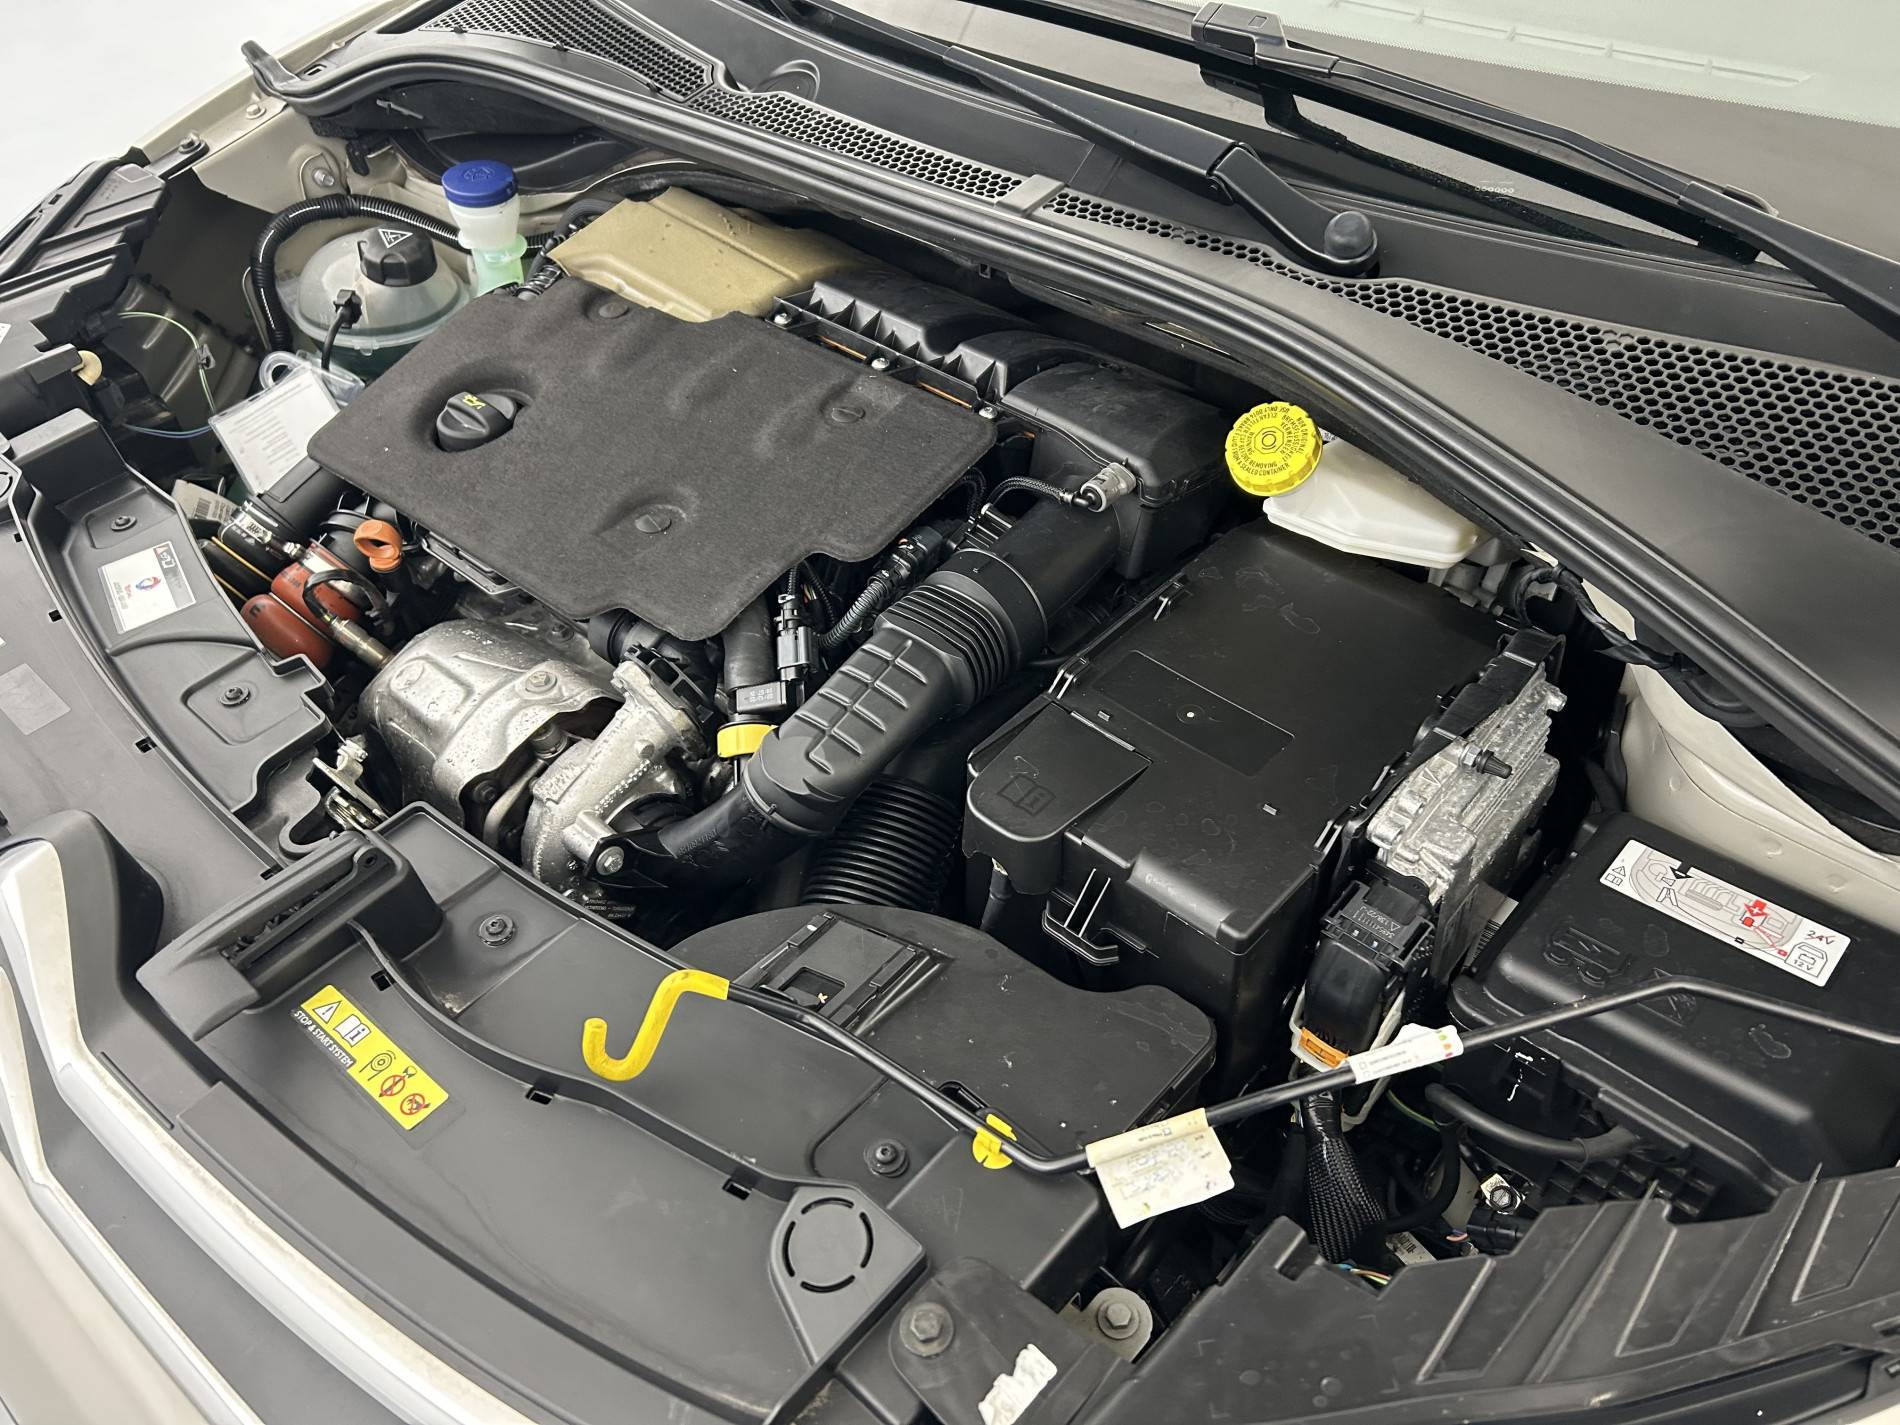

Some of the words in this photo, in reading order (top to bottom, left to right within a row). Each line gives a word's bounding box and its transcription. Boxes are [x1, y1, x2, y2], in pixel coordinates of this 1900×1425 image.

[1237, 417, 1252, 432] BRAKE
[1296, 417, 1306, 428] NUR
[1281, 422, 1293, 455] VERWENDEN
[1298, 429, 1308, 455] ORIGINAL
[1240, 463, 1258, 476] SEALED
[1249, 461, 1277, 469] REMOVING
[1259, 463, 1290, 476] CONTAINER
[294, 1011, 312, 1026] STOP
[312, 1029, 333, 1047] START
[329, 1045, 353, 1067] SYSTEM
